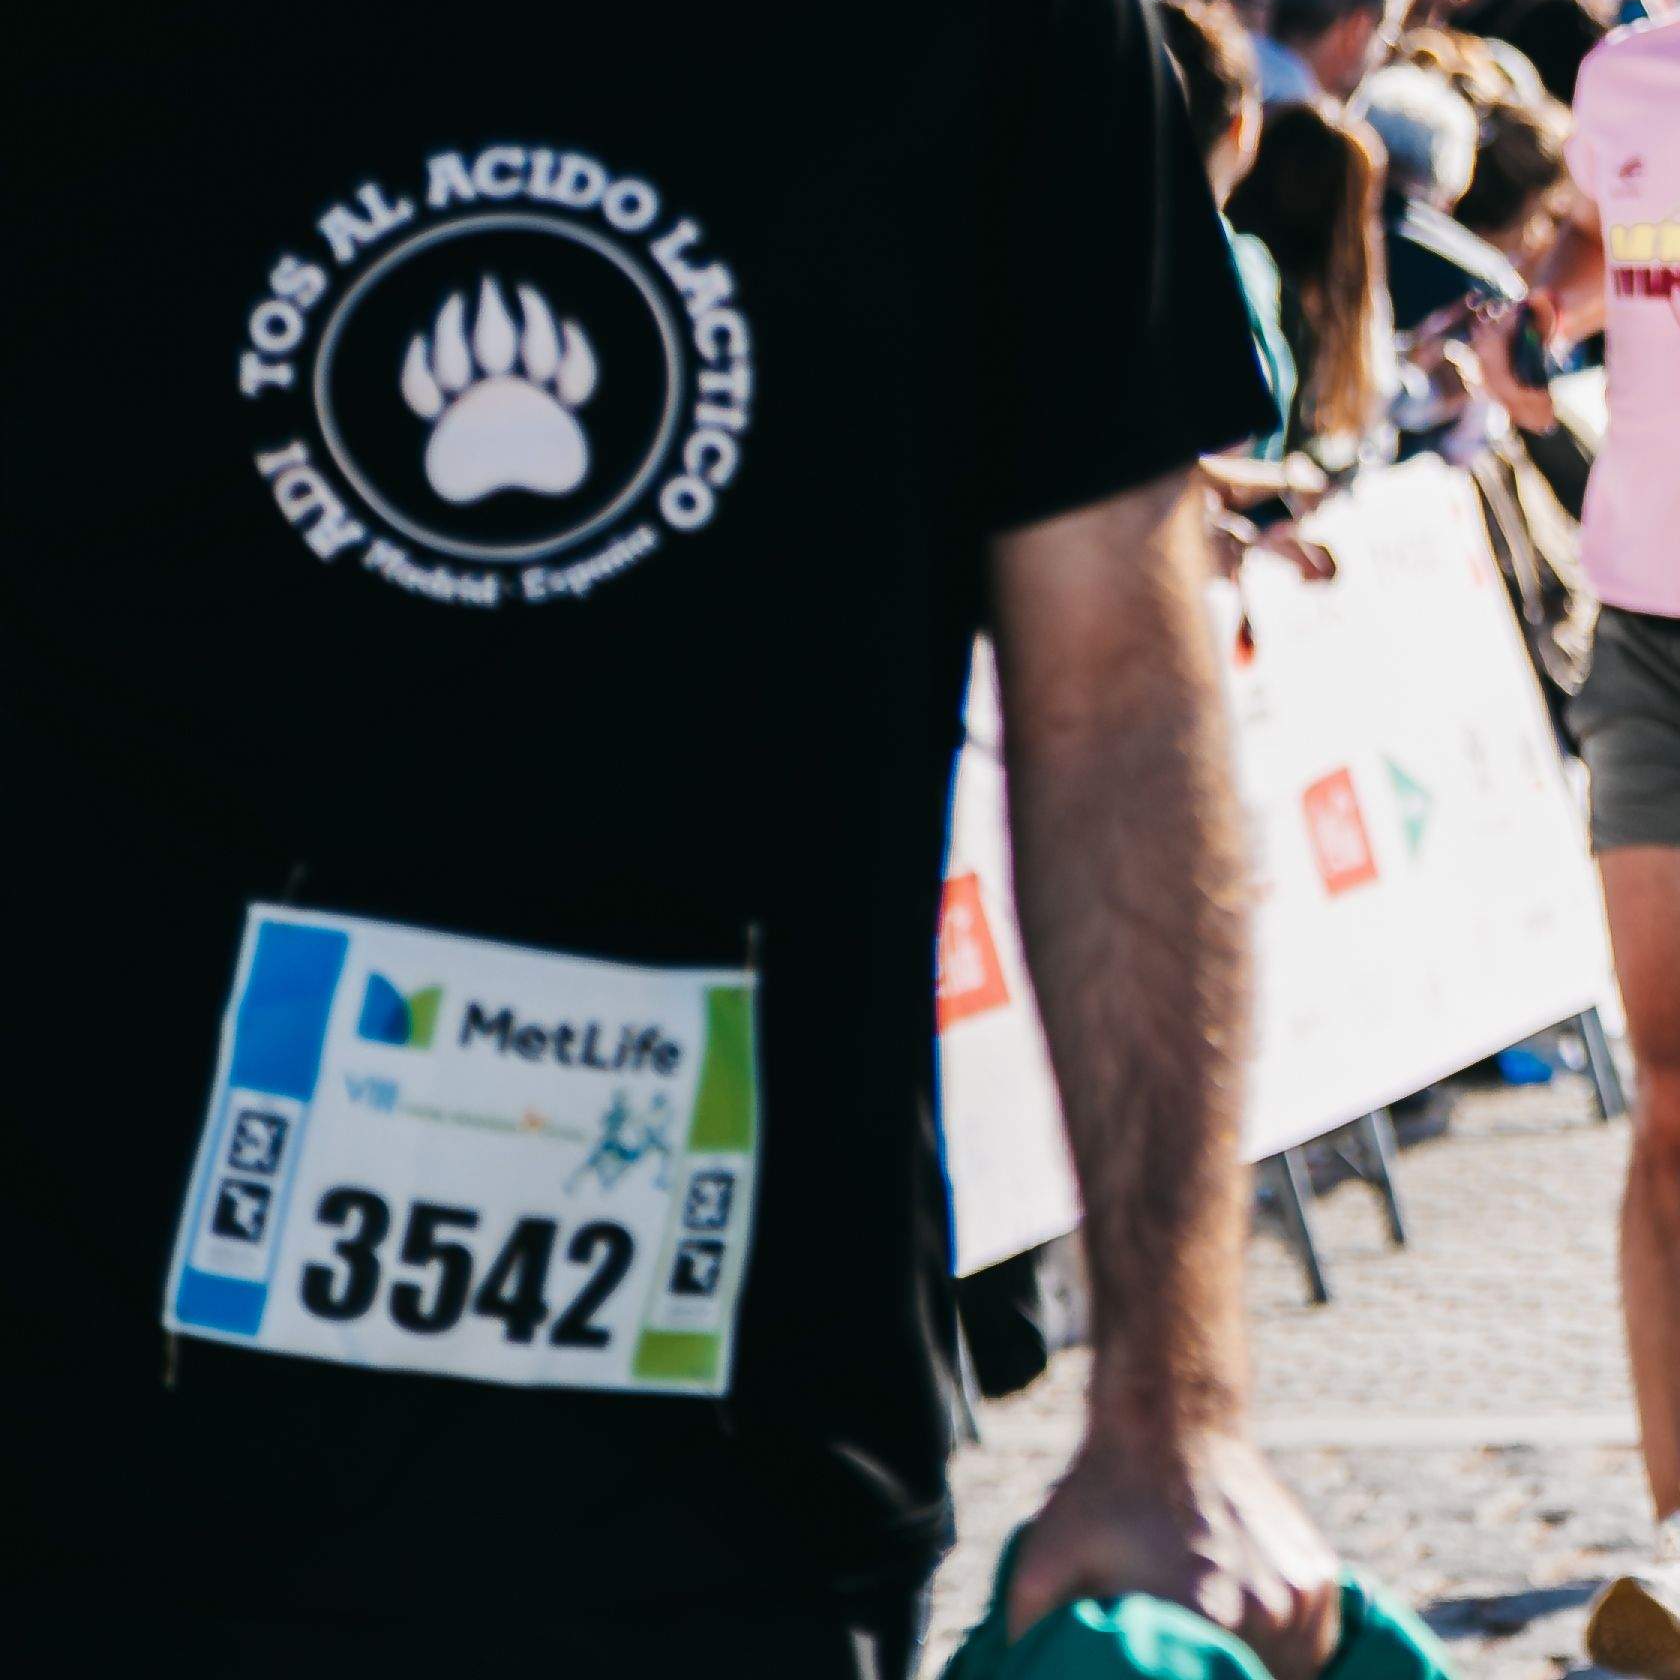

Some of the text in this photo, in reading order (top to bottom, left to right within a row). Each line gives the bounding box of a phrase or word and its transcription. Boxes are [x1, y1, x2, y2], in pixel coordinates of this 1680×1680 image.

[316, 181, 416, 263] AL
[426, 145, 660, 232] ACIDO
[650, 217, 753, 530] LACTICO
[458, 1000, 684, 1077] MetLife
[300, 1184, 635, 1350] 3542
